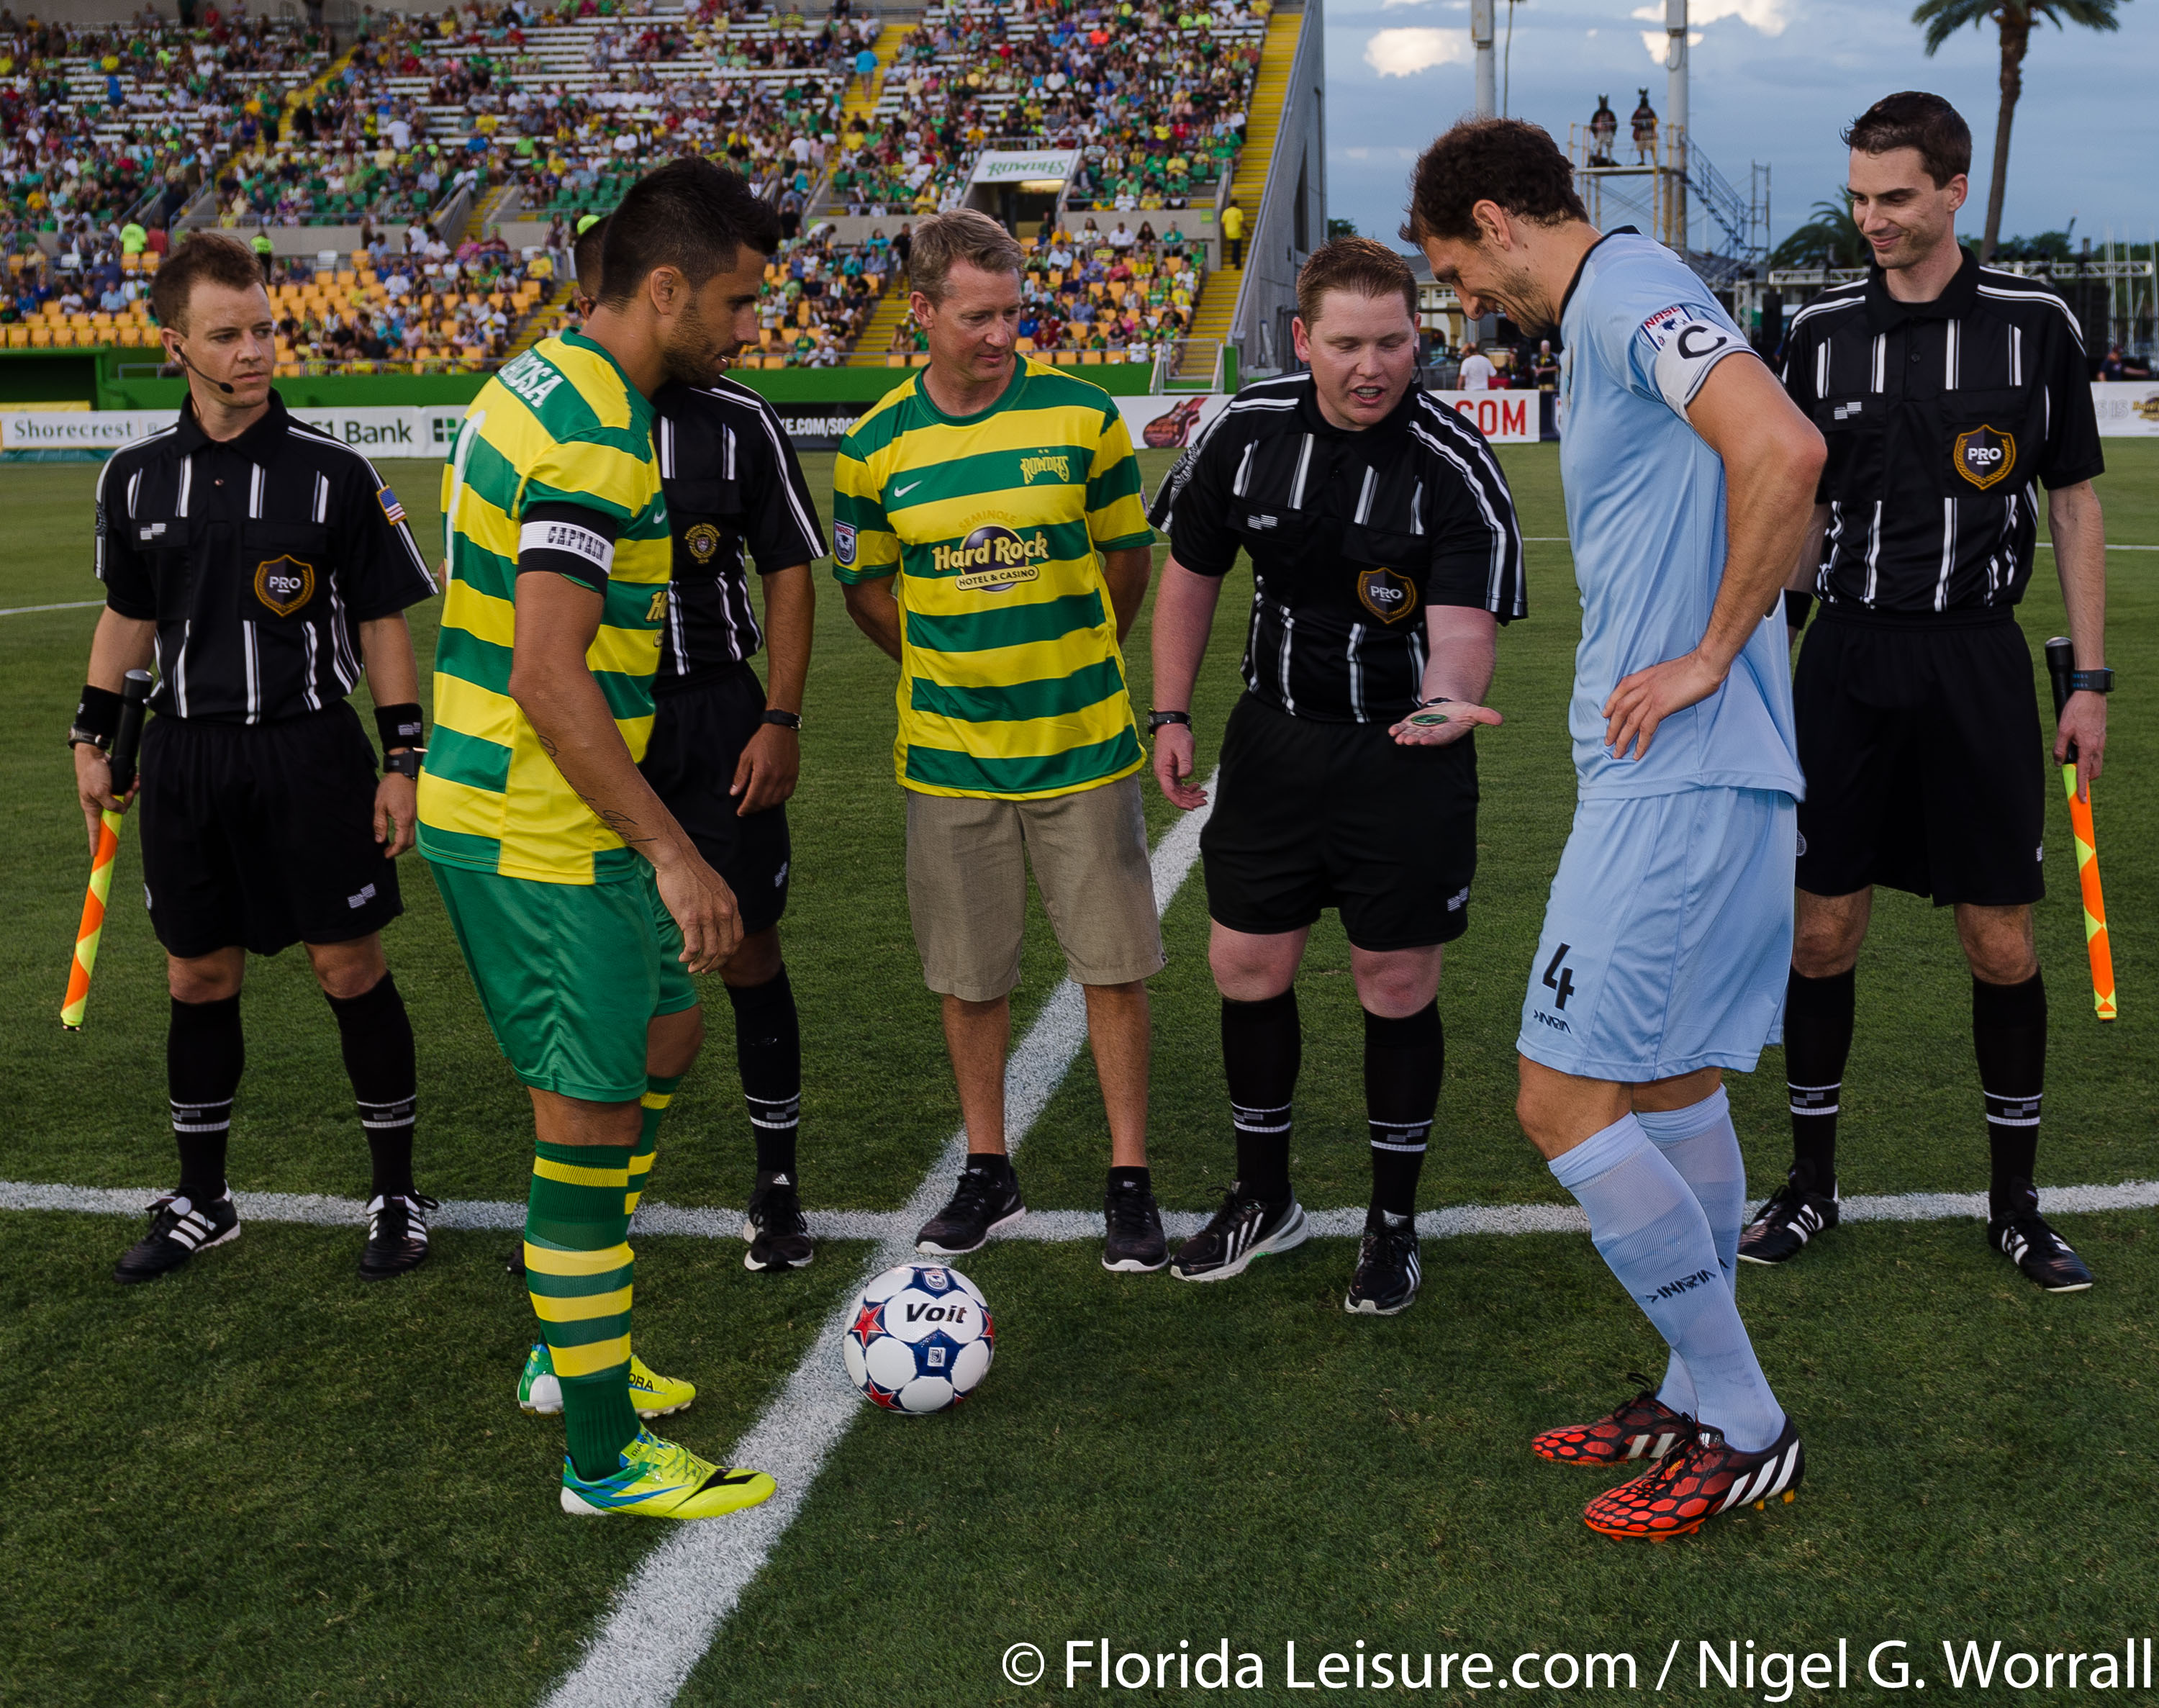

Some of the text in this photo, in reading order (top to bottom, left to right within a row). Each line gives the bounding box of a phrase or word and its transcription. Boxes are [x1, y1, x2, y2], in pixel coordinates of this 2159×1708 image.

[1644, 306, 1680, 330] NASL
[1678, 325, 1727, 360] C
[14, 419, 133, 440] Shorecrest
[344, 418, 413, 444] Bank
[1968, 447, 2002, 461] PRO
[958, 509, 1019, 531] SEMINOLE
[547, 525, 606, 562] CAPTAIN
[931, 530, 1050, 571] Hard Rock
[269, 576, 302, 589] PRO
[958, 575, 990, 587] HOTEL
[1000, 569, 1036, 580] CASINO
[1371, 586, 1403, 599] PRO
[1542, 941, 1575, 1012] 4
[905, 1302, 967, 1324] Voit
